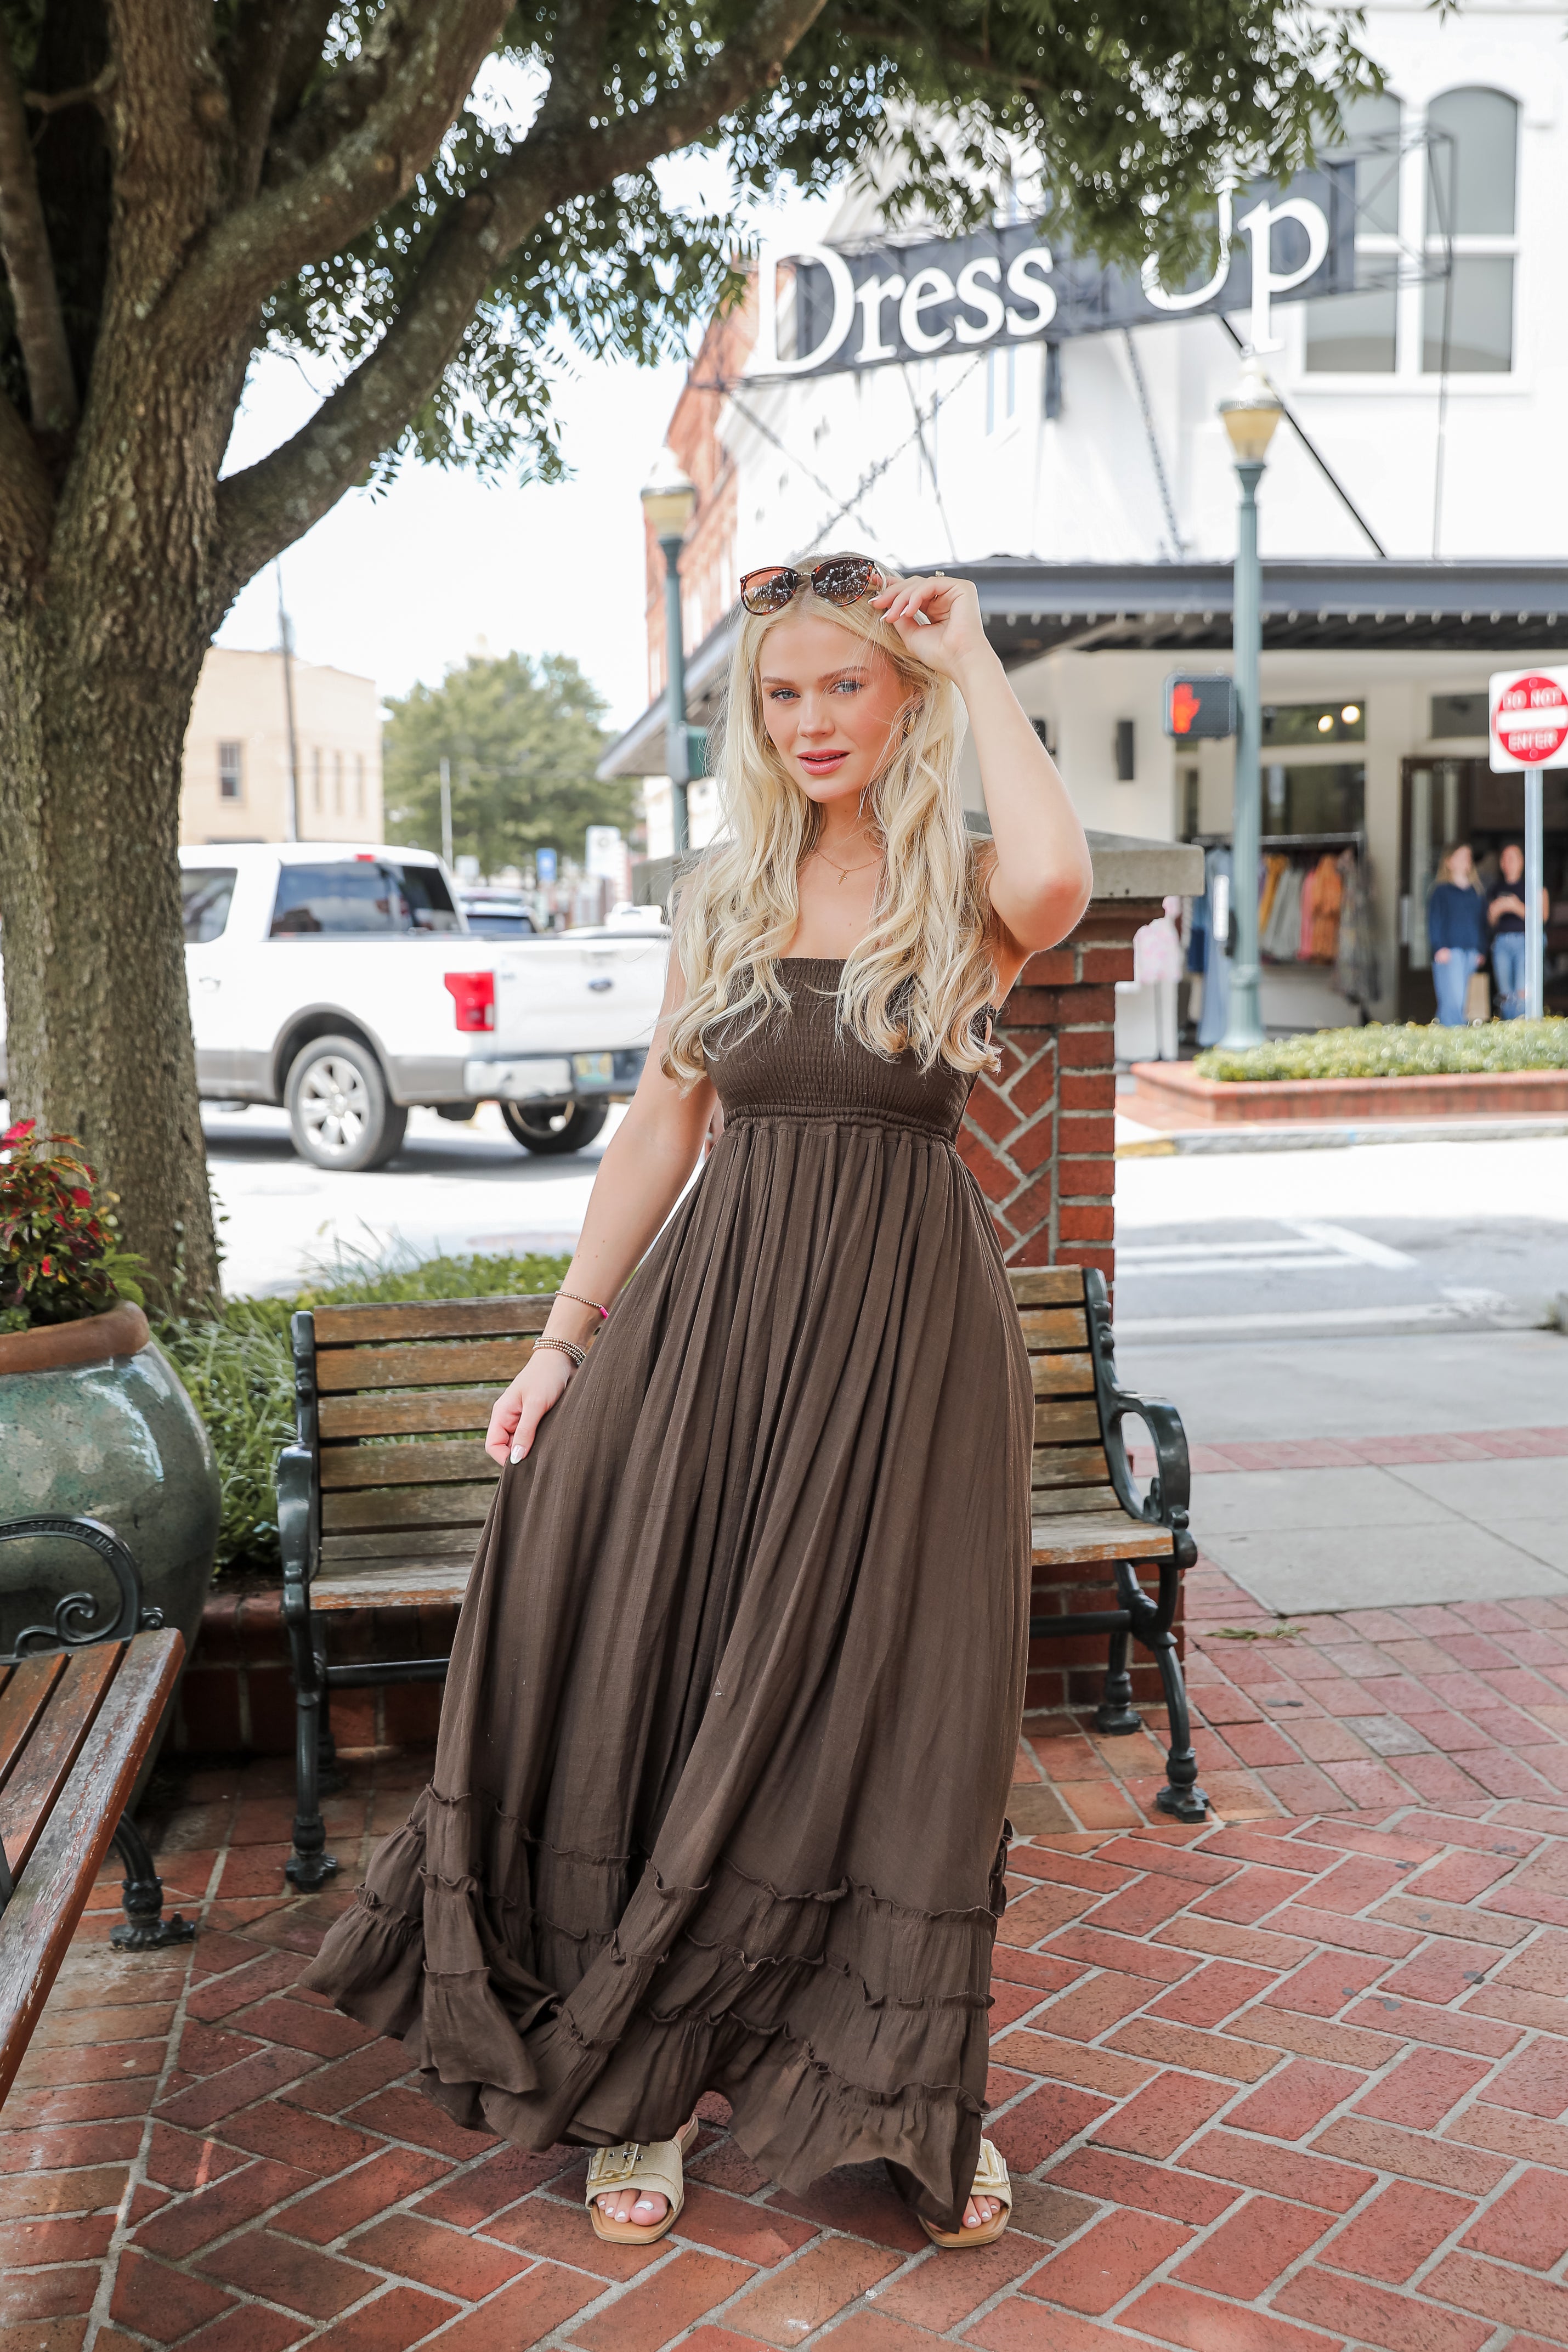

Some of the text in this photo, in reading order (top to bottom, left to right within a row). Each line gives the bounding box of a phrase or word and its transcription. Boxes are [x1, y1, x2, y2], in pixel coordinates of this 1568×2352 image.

[744, 176, 1329, 375] Dress Up
[1502, 686, 1562, 710] DO NOT
[1508, 730, 1559, 751] ENTER
